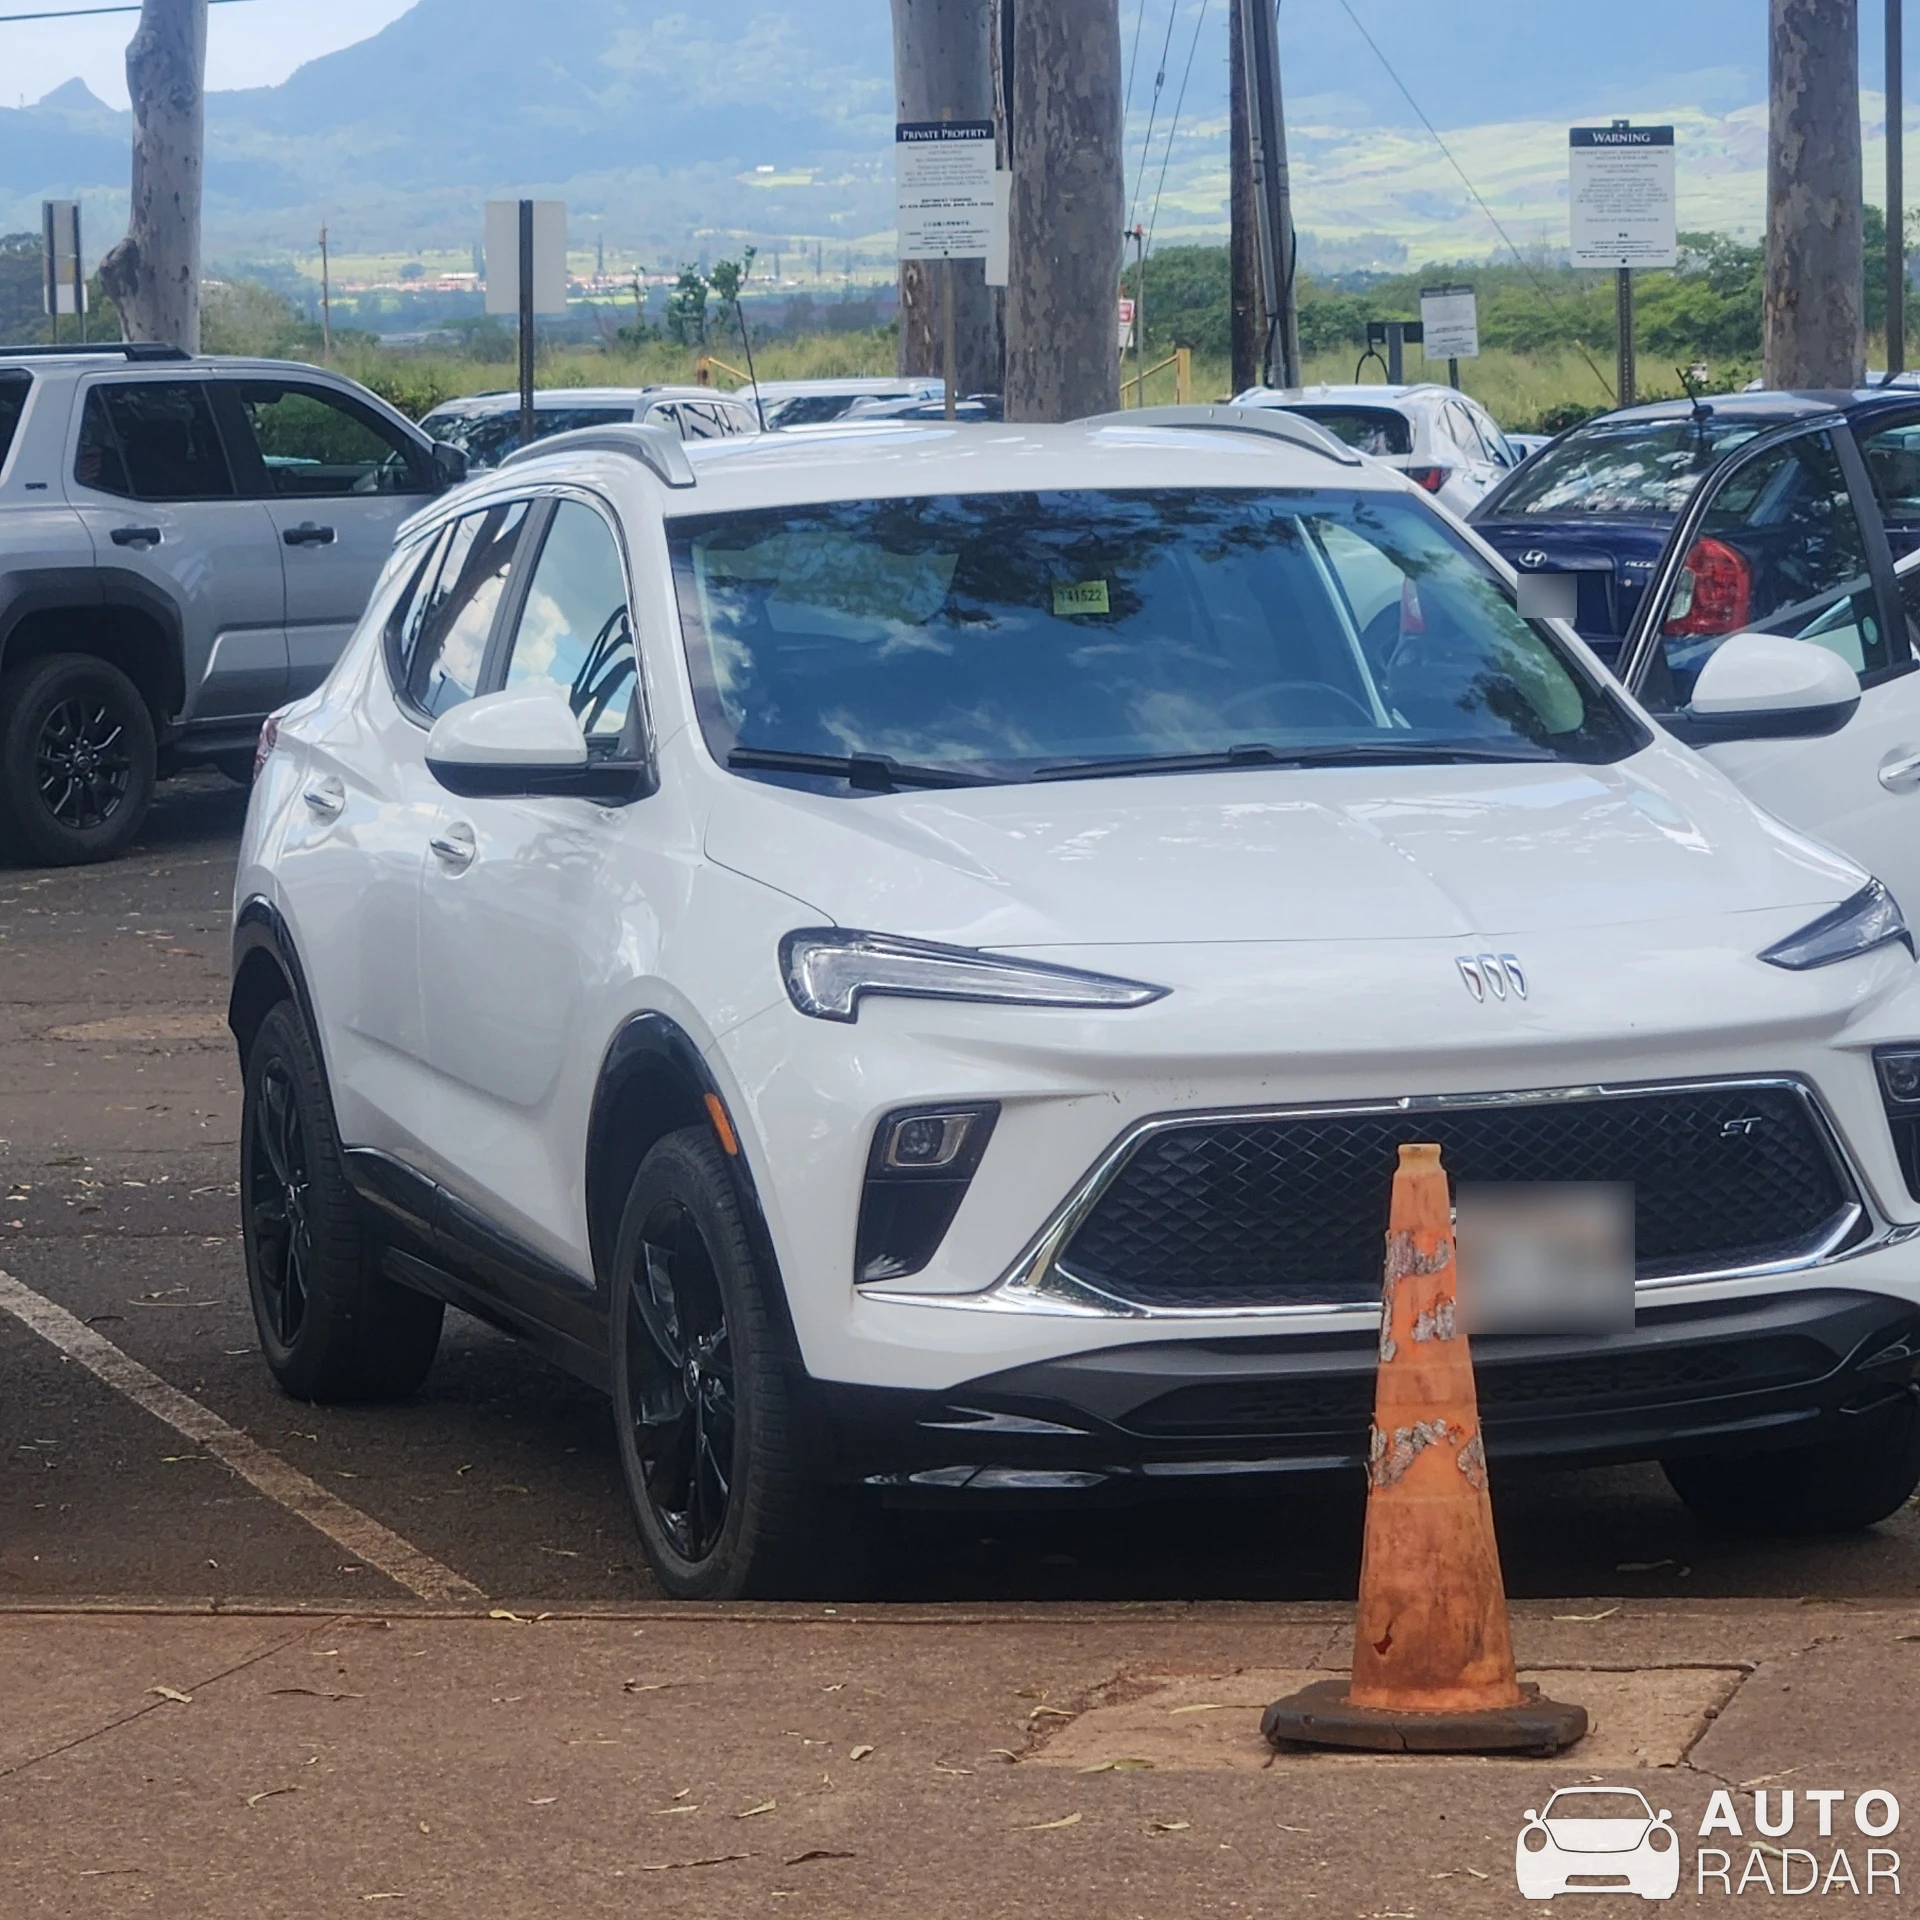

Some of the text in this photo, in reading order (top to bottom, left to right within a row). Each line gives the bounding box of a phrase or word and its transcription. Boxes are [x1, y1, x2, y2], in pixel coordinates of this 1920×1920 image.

[902, 129, 988, 140] PRIVATE PROPERTY
[1592, 132, 1650, 143] WARNING
[1625, 560, 1657, 569] ACCE
